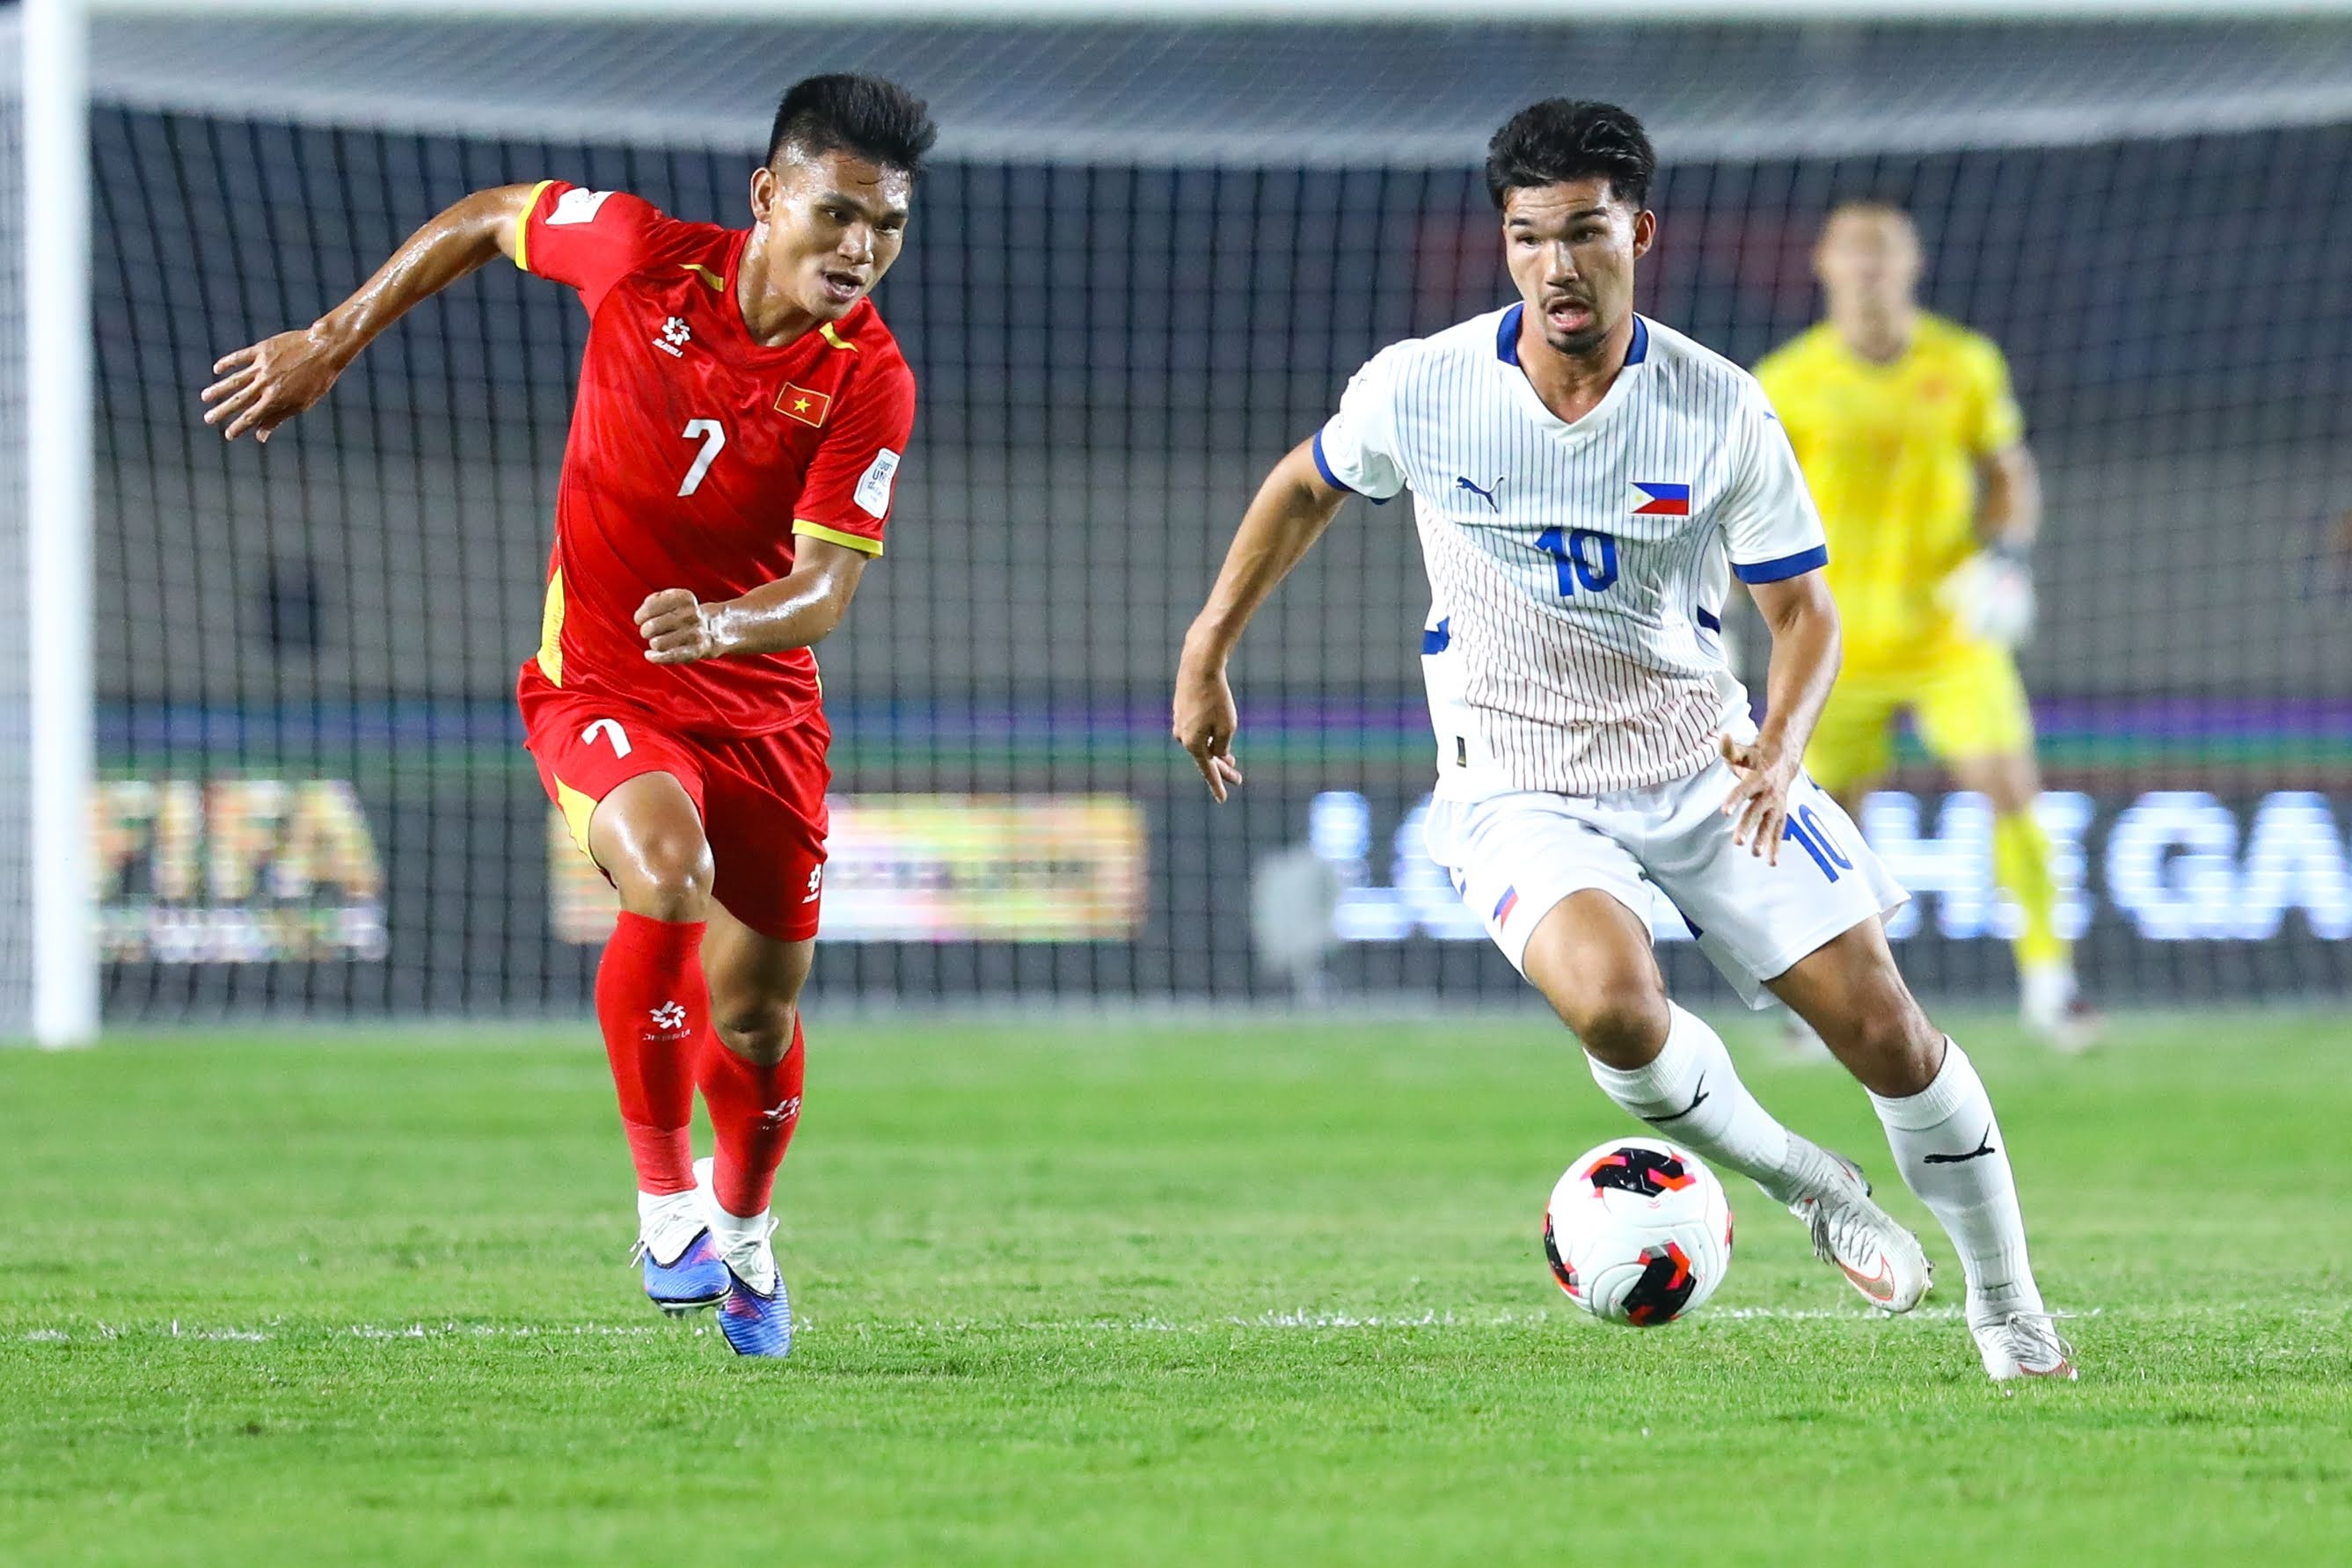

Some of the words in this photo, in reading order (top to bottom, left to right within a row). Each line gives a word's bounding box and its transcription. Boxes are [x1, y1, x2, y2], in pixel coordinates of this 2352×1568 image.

[676, 418, 727, 498] 7
[1534, 526, 1618, 598] 10
[581, 718, 633, 760] 7
[86, 779, 385, 899] FIFA
[1781, 803, 1854, 884] 10
